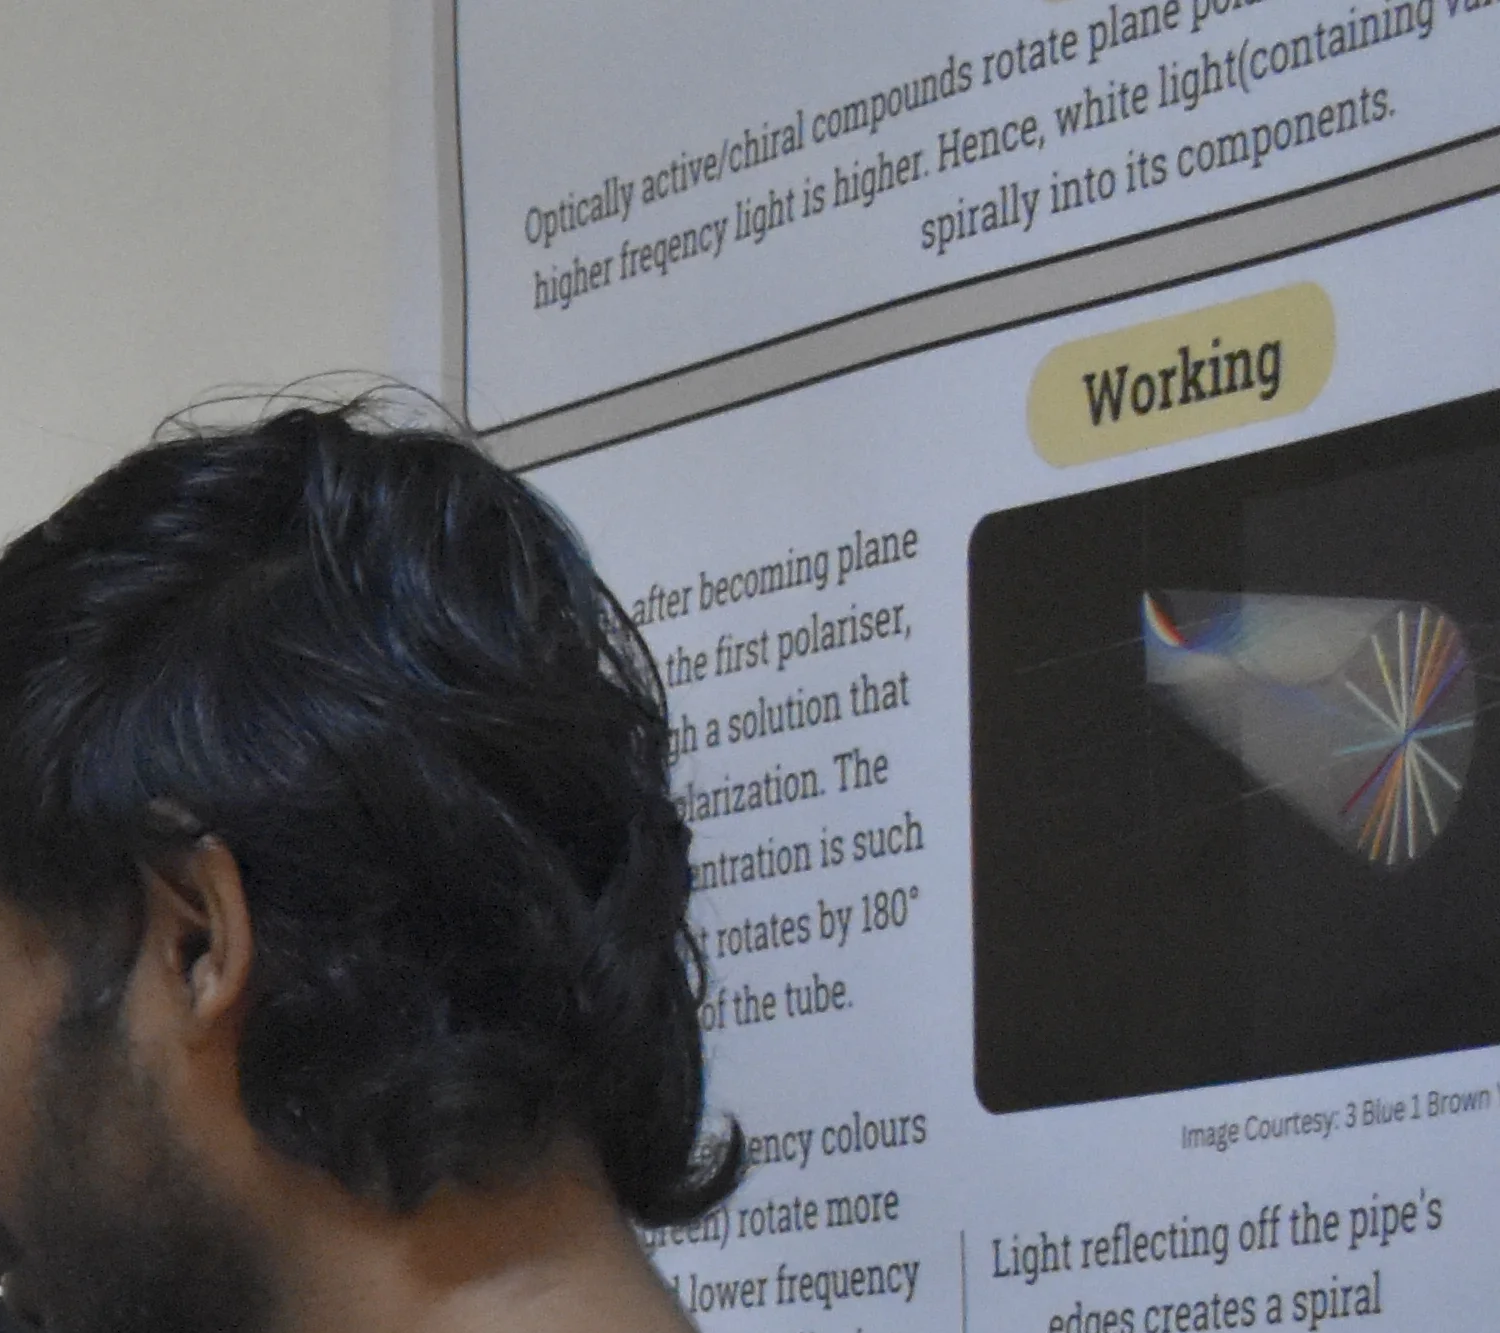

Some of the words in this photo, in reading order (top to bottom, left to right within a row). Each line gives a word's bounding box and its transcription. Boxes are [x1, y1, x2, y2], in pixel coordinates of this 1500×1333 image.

[524, 176, 634, 248] Optically
[641, 110, 804, 204] active/chiral
[812, 55, 972, 143] compounds
[983, 29, 1077, 86] rotate
[1088, 0, 1180, 64] plane
[533, 255, 613, 309] higher
[620, 217, 728, 280] freqency
[734, 187, 795, 245] light
[803, 178, 825, 218] is
[834, 148, 929, 207] higher.
[937, 115, 1046, 172] Hence,
[1056, 81, 1148, 137] white
[1159, 0, 1434, 111] light(containing
[921, 185, 1040, 255] spirally
[1051, 166, 1116, 213] into
[1127, 150, 1167, 193] its
[1177, 87, 1396, 168] components.
[1083, 333, 1283, 428] Working
[632, 584, 692, 627] after
[699, 547, 829, 612] becoming
[837, 528, 919, 585] plane
[665, 645, 708, 688] the
[714, 630, 770, 677] first
[777, 603, 912, 671] polariser,
[706, 716, 720, 748] a
[727, 689, 841, 744] solution
[849, 671, 910, 716] that
[834, 748, 889, 792] The
[690, 837, 812, 892] entration
[820, 827, 844, 868] is
[853, 811, 925, 862] such
[716, 913, 811, 959] rotates
[819, 899, 853, 947] by
[862, 885, 919, 933] 180°
[700, 986, 727, 1032] of
[734, 984, 777, 1026] the
[785, 972, 854, 1018] tube.
[821, 1111, 927, 1156] colours
[1182, 1122, 1240, 1152] Image
[1245, 1107, 1341, 1142] Courtesy:
[1345, 1102, 1359, 1128] 3
[1362, 1097, 1406, 1127] Blue
[1410, 1094, 1422, 1120] 1
[1427, 1086, 1491, 1117] Brown
[737, 1196, 818, 1238] rotate
[826, 1190, 900, 1228] more
[992, 1231, 1072, 1285] Light
[1080, 1214, 1230, 1268] reflecting
[1238, 1203, 1282, 1252] off
[1289, 1200, 1341, 1246] the
[1348, 1187, 1444, 1250] pipe's
[688, 1273, 768, 1313] lower
[775, 1259, 920, 1311] frequency
[1266, 1293, 1283, 1324] a
[1292, 1270, 1383, 1332] spiral
